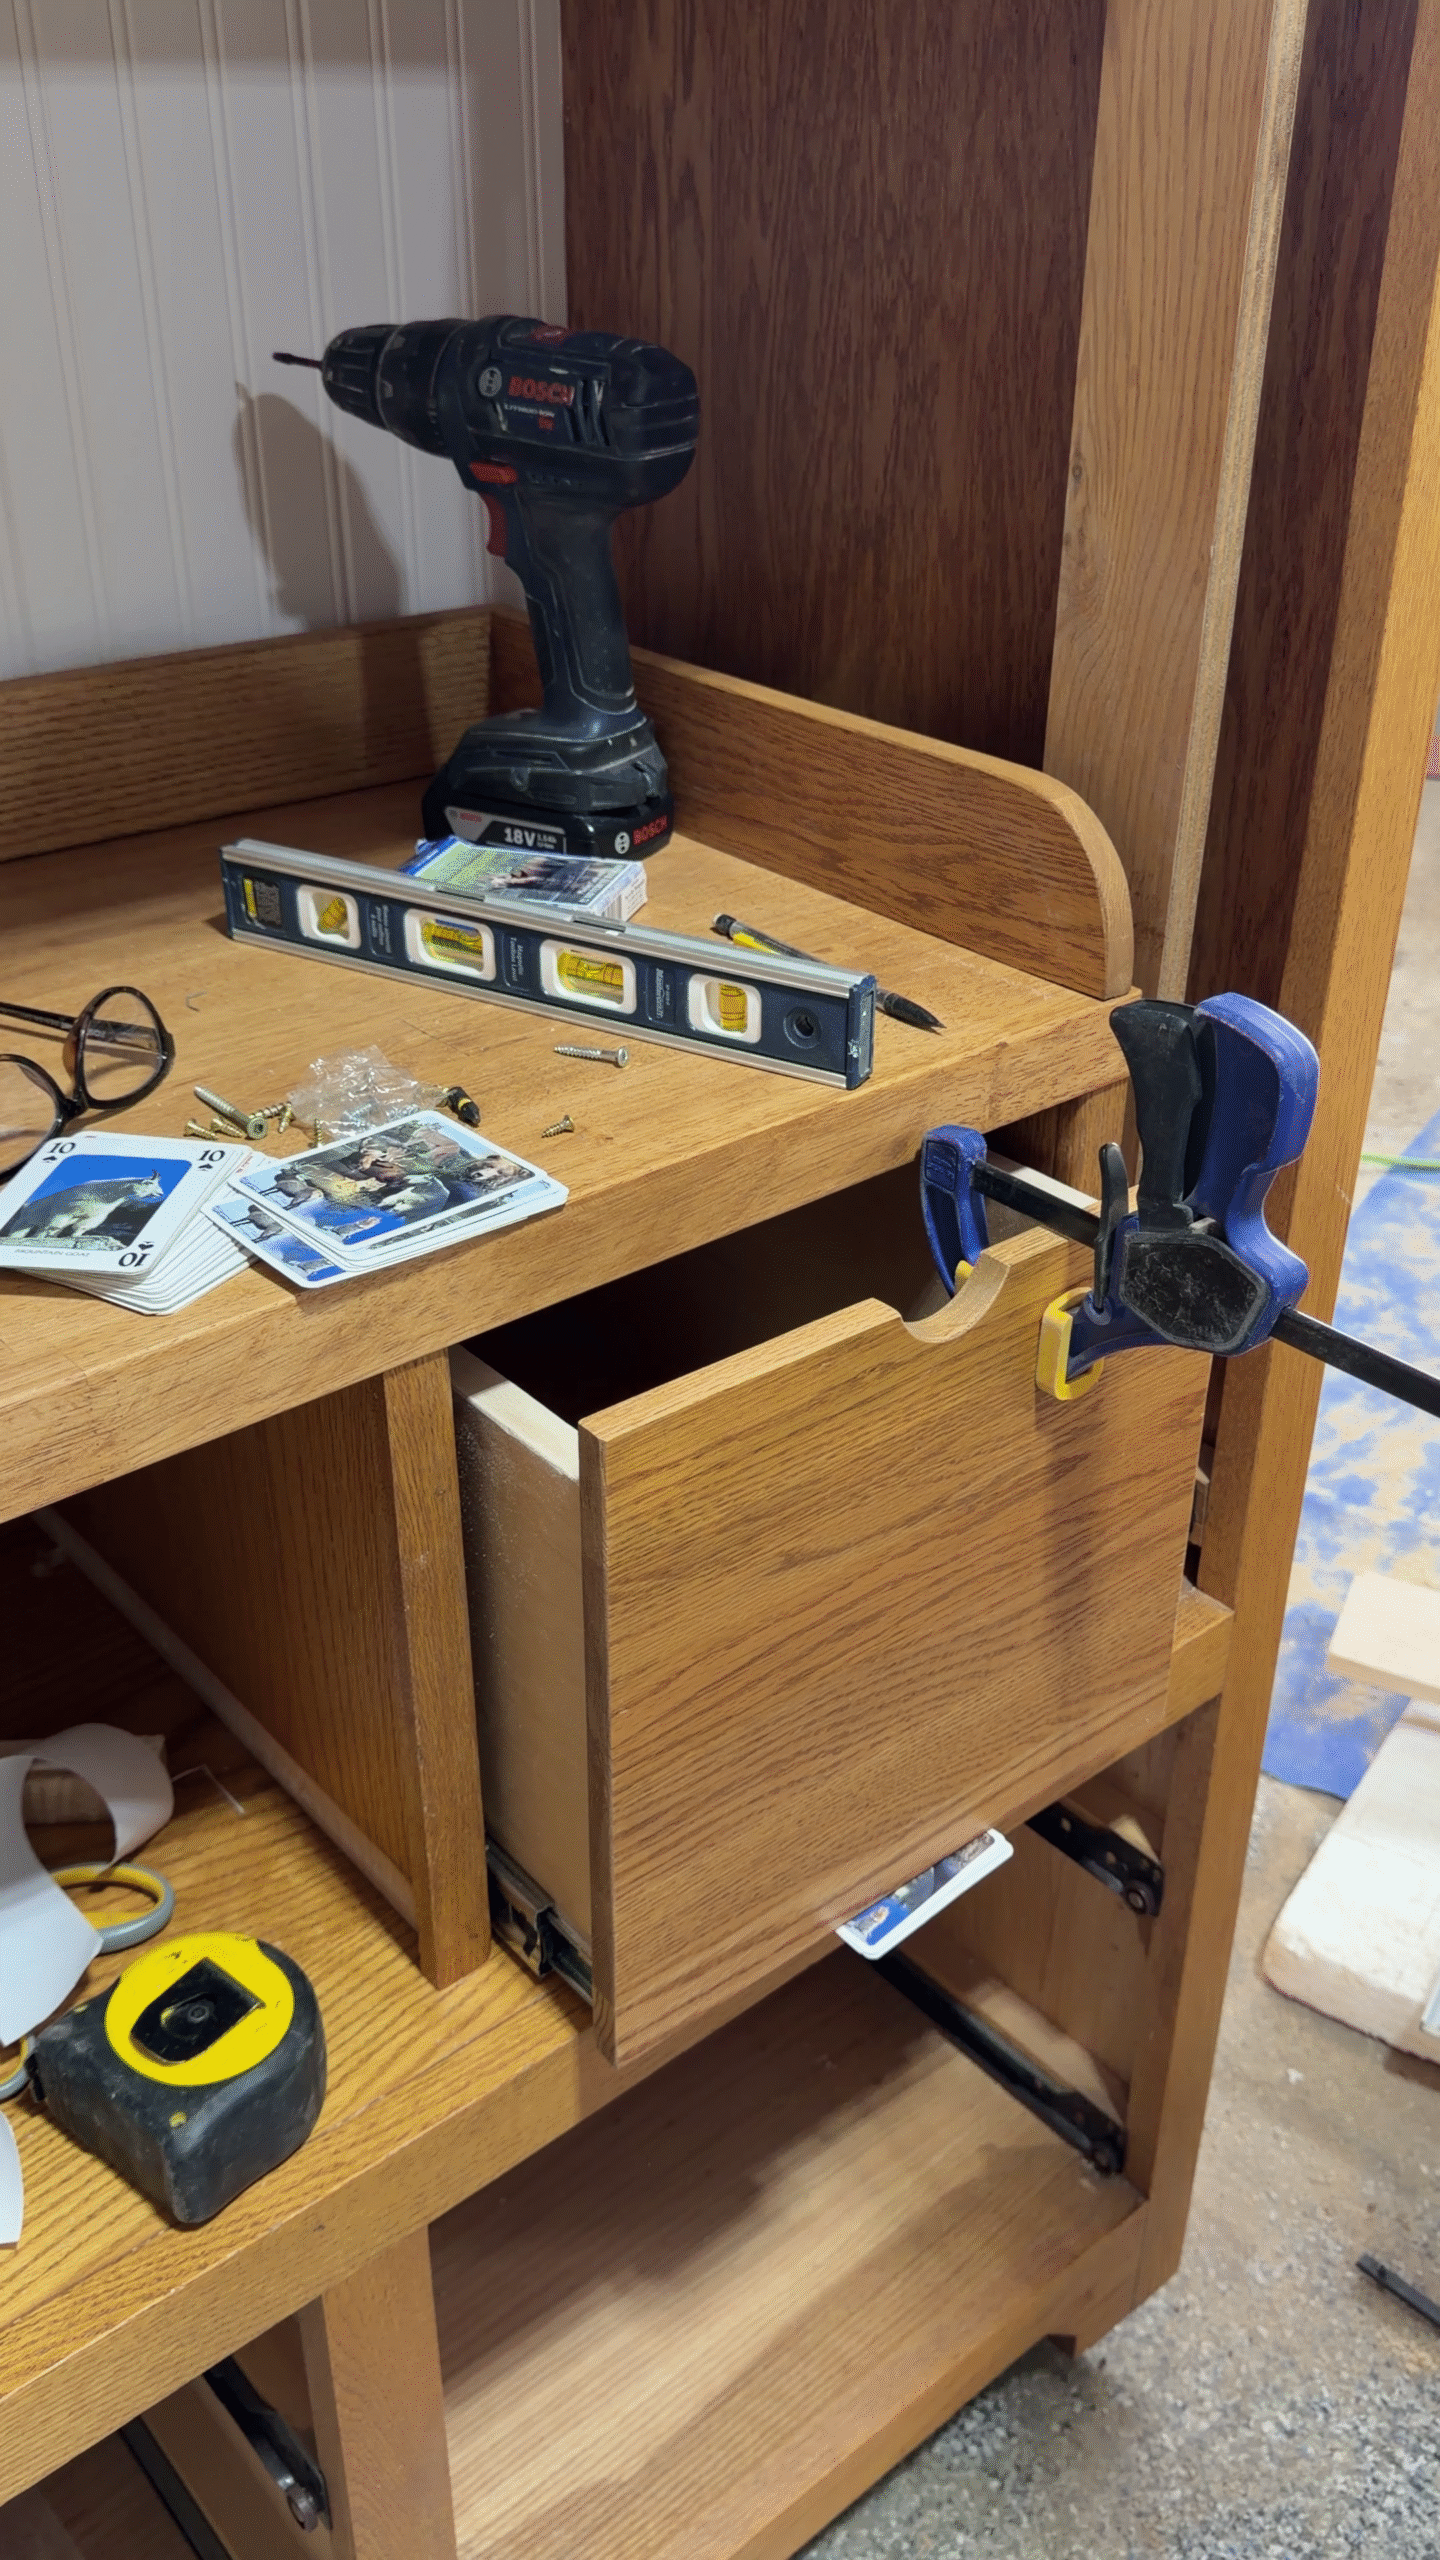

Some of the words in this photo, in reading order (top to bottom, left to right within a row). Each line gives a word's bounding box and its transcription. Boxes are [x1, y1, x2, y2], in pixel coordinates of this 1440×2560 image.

[508, 376, 575, 406] BOSCH
[504, 826, 536, 847] 18V
[633, 815, 667, 845] BOSCH
[47, 1141, 76, 1154] 10
[198, 1149, 226, 1162] 10
[117, 1252, 152, 1268] 10
